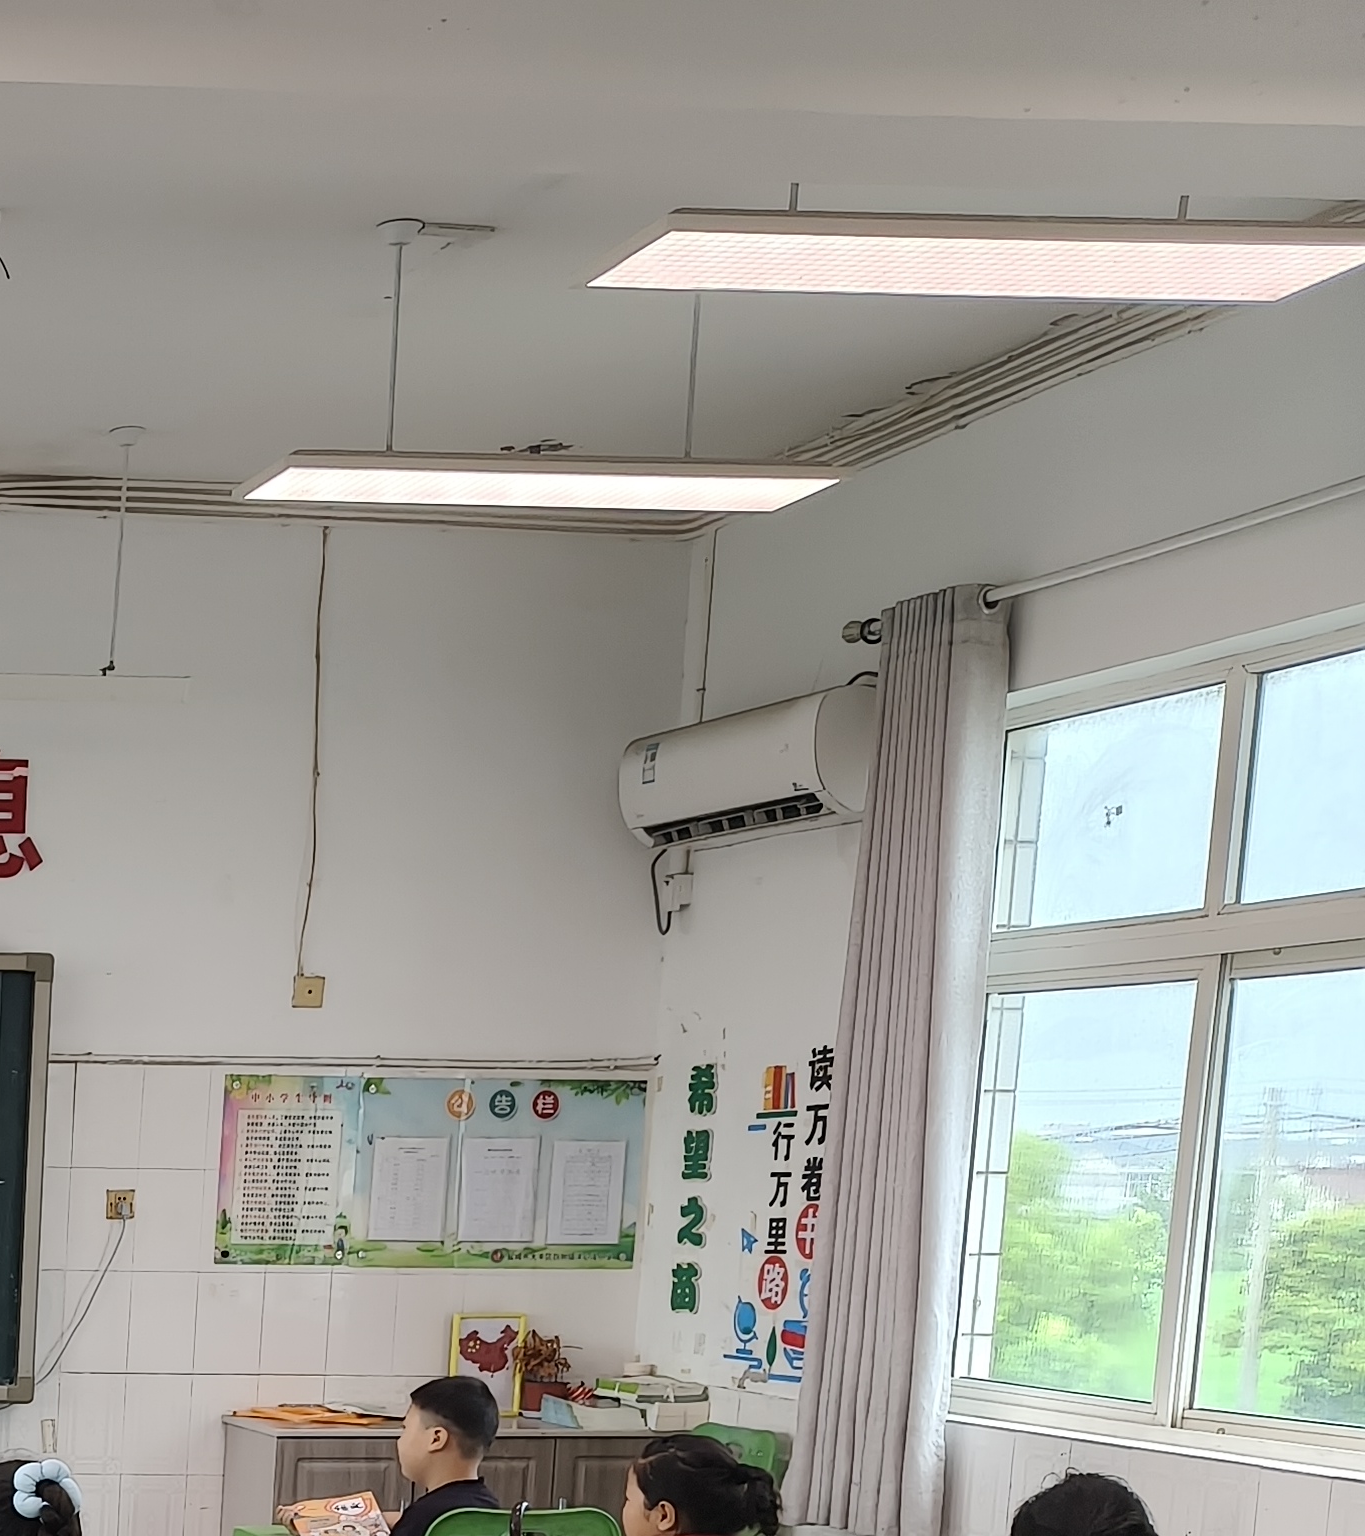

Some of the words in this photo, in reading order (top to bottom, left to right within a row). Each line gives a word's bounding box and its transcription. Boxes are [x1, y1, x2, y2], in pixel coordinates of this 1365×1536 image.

[451, 1093, 556, 1116] 公告栏
[671, 1064, 716, 1312] 希望之苗
[760, 1121, 796, 1306] 行万里路
